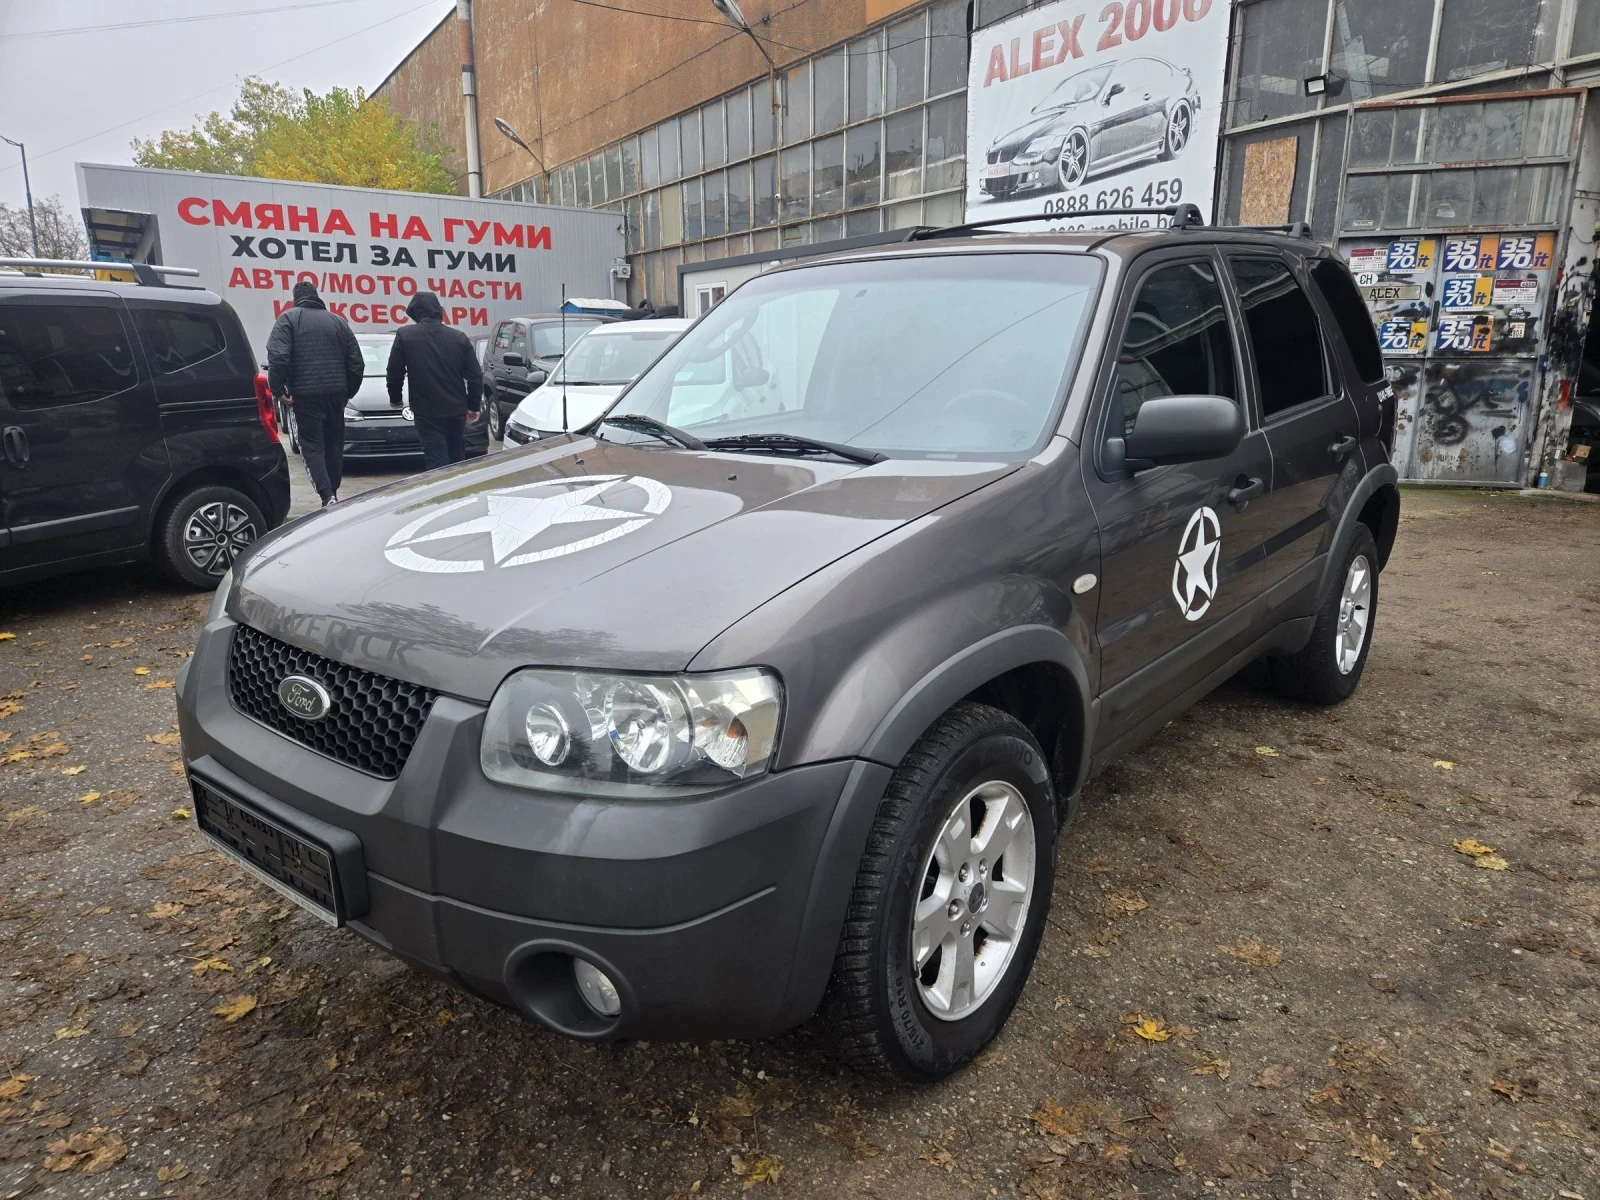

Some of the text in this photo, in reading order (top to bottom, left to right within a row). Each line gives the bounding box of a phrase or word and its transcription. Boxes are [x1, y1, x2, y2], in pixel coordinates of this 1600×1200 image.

[983, 14, 1086, 88] ALEX
[1043, 178, 1183, 221] 0888 626 459
[177, 196, 553, 250] СМЯНА НА ГУМИ
[230, 235, 517, 273] ХОТЕЛ ЗА ГУМИ
[1390, 242, 1418, 256] 35
[1446, 240, 1479, 256] 35
[1501, 238, 1535, 254] 35
[228, 267, 523, 301] АВТО/МОТО ЧАСТИ
[1360, 274, 1373, 285] CH
[1446, 280, 1475, 294] 35
[1369, 287, 1401, 299] ALEX
[329, 302, 488, 327] КСЕСРИ
[1382, 323, 1411, 336] 35
[1441, 320, 1474, 335] 35
[250, 602, 418, 668] MAVERICK
[287, 683, 316, 712] Ford
